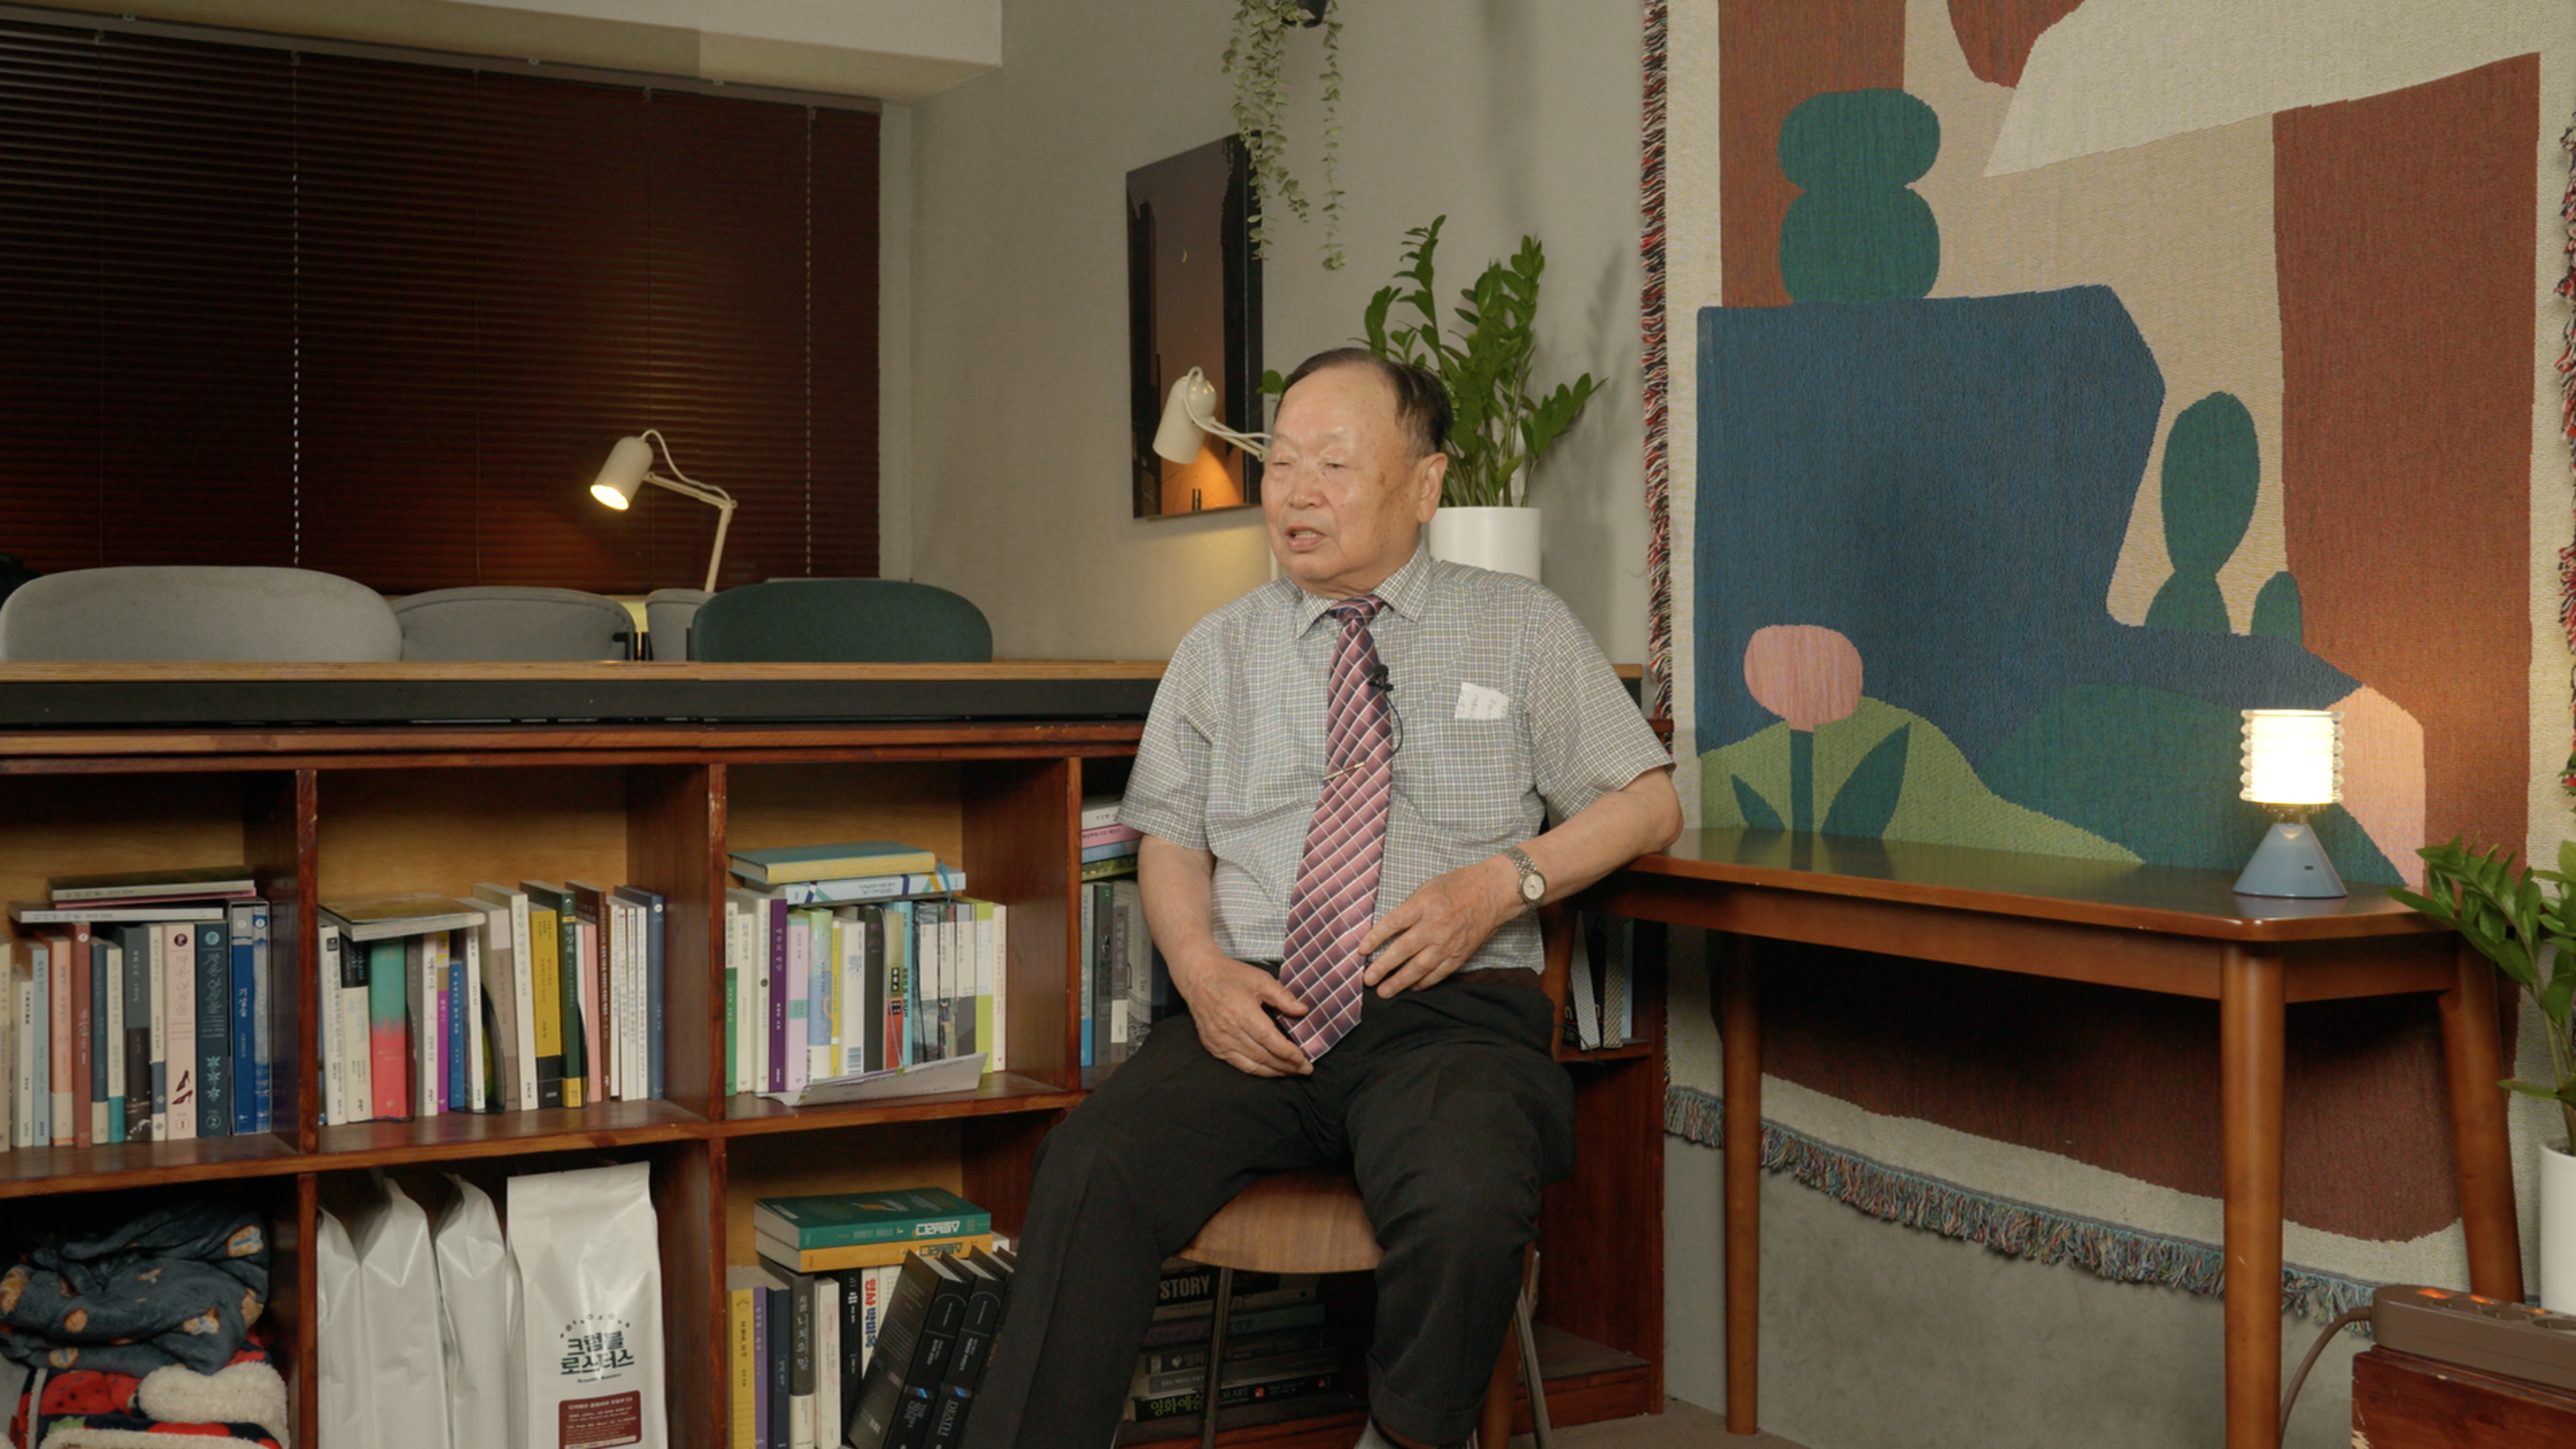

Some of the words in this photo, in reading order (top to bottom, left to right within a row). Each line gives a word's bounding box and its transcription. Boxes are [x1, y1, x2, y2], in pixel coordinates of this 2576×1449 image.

[565, 925, 574, 954] 명상록
[203, 953, 222, 976] 작은
[205, 978, 222, 1014] 아씨들
[238, 988, 248, 1017] 기생충
[1160, 1275, 1210, 1300] STORY
[561, 1349, 634, 1375] 로스터스
[939, 1400, 960, 1437] DEATH
